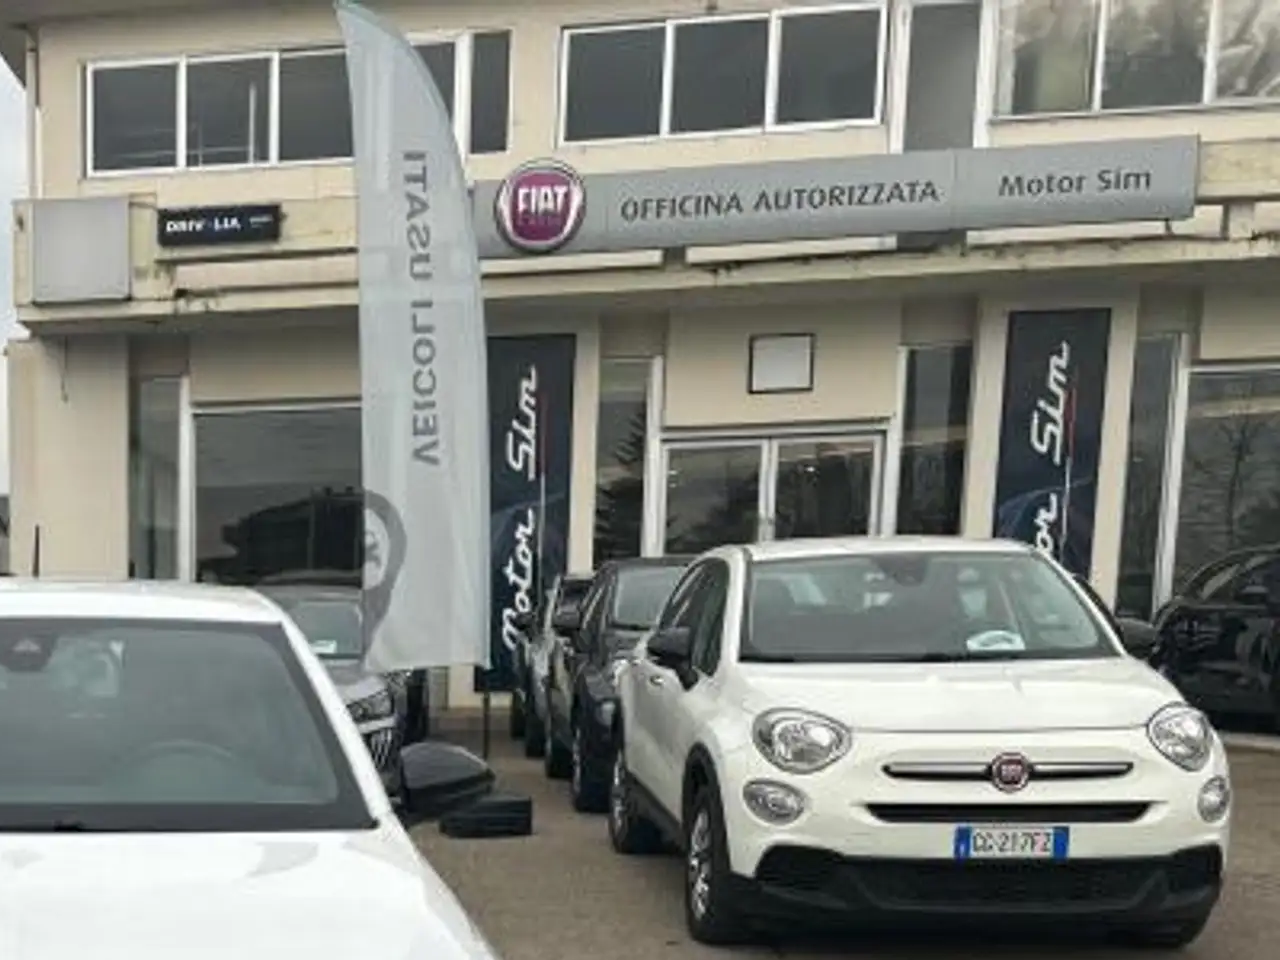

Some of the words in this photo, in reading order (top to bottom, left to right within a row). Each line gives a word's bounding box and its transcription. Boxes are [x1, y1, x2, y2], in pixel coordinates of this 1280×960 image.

[998, 174, 1086, 197] Motor
[1097, 166, 1152, 191] Sim
[517, 184, 569, 216] FIAT
[621, 192, 743, 222] OFFICINA
[753, 180, 940, 212] AUTORIZZATA
